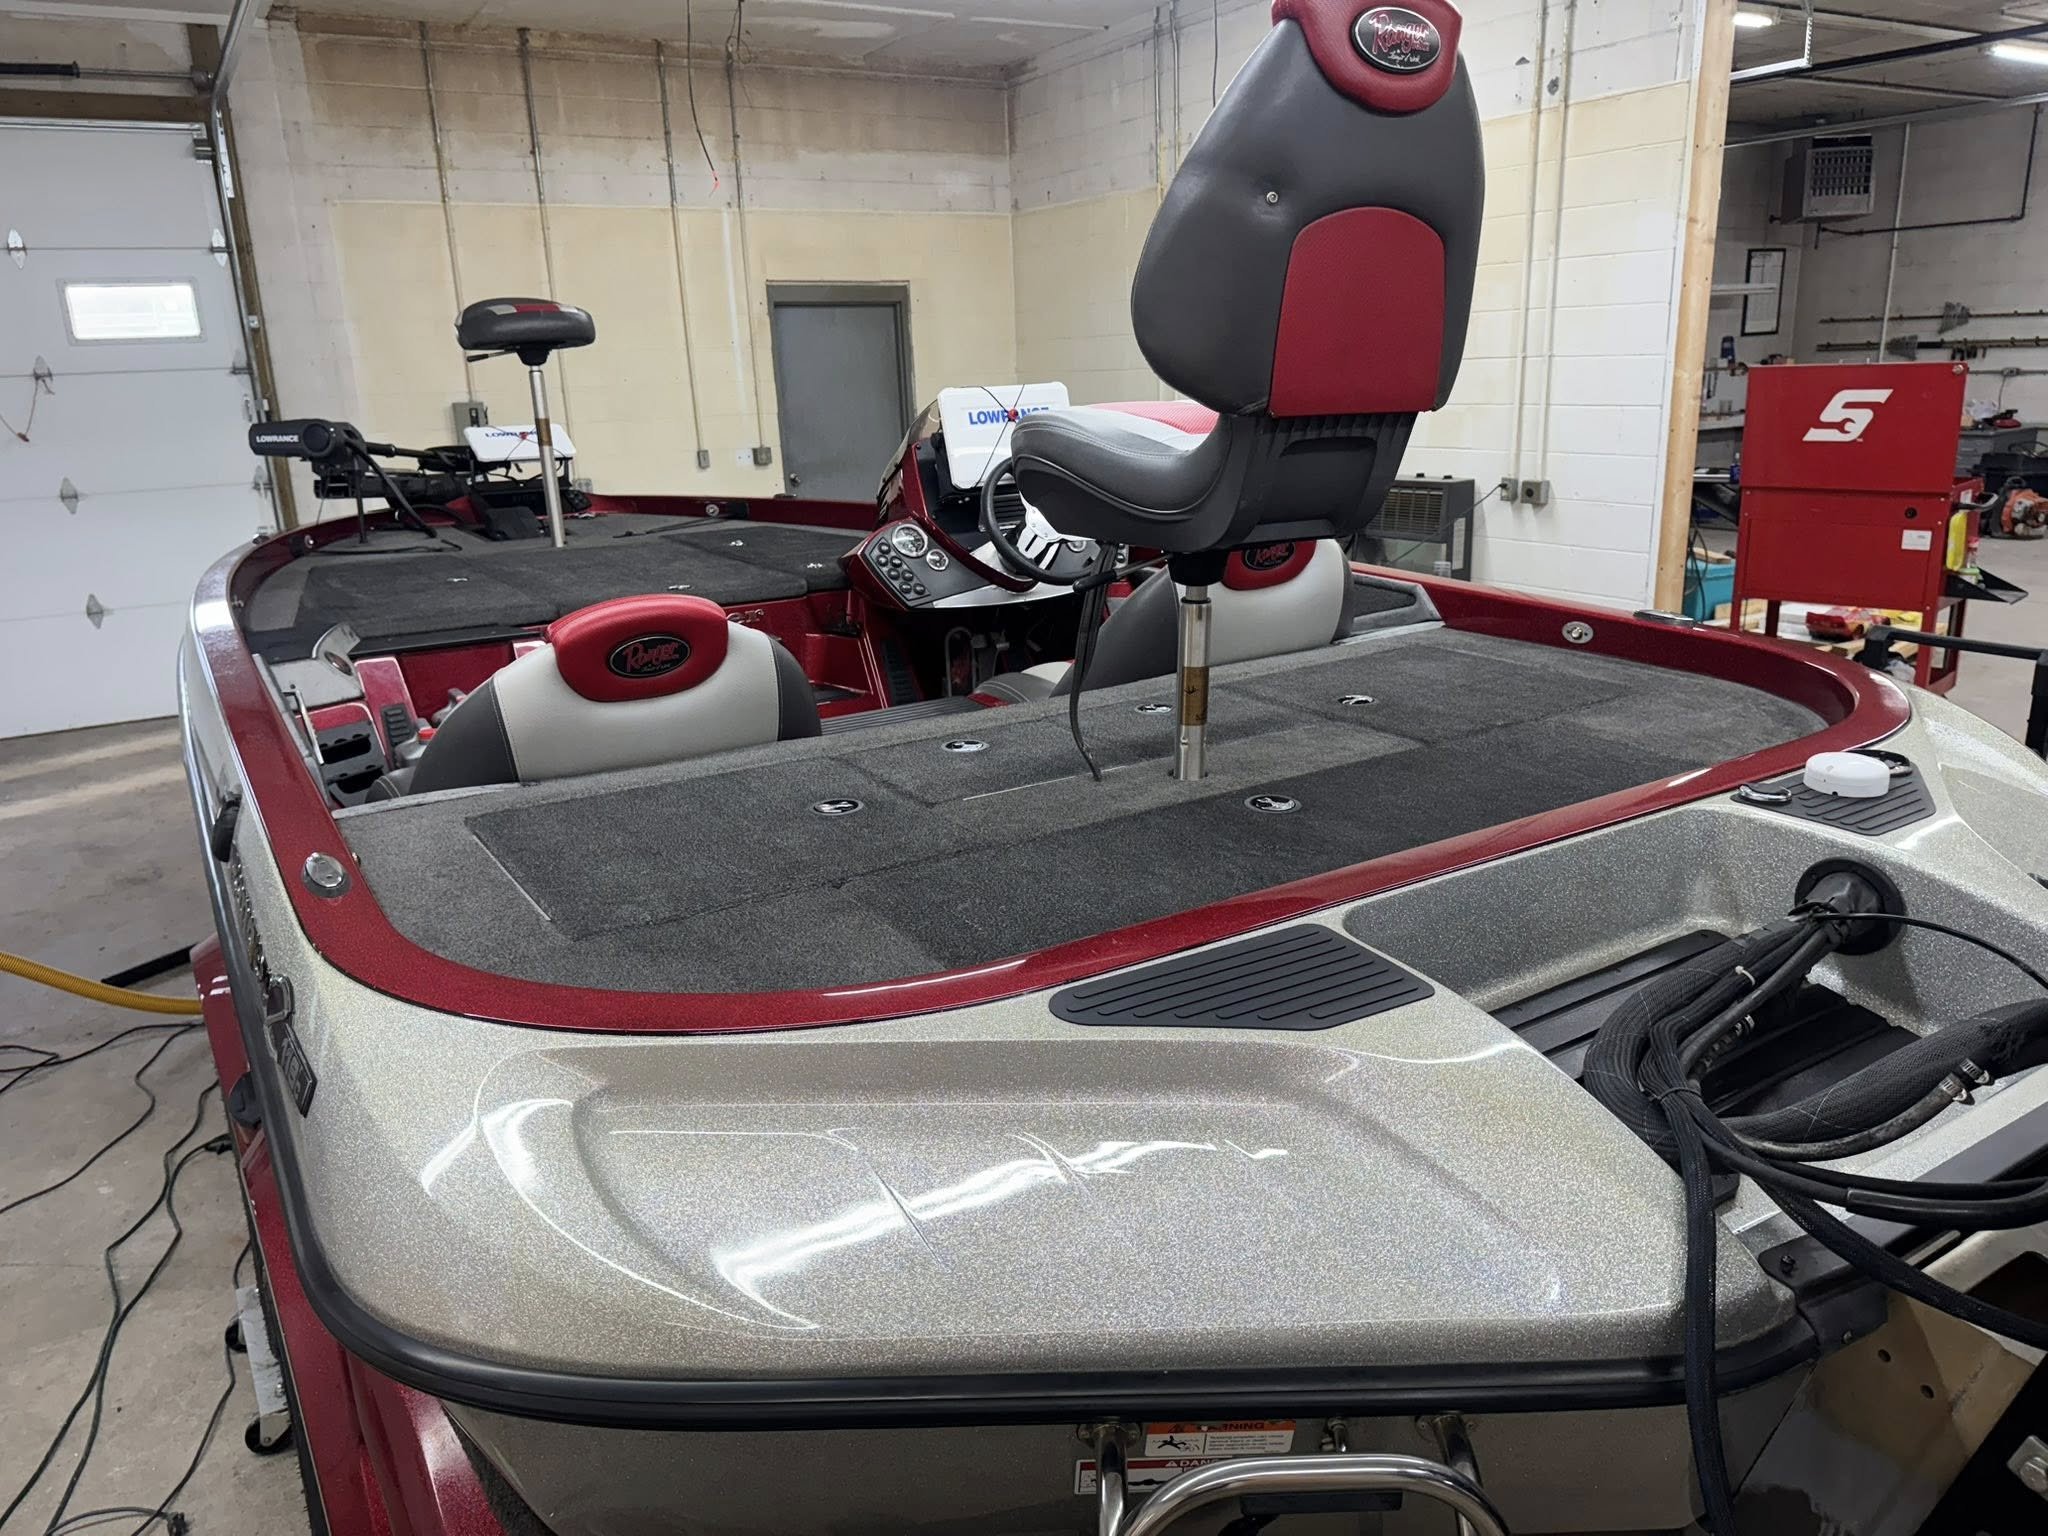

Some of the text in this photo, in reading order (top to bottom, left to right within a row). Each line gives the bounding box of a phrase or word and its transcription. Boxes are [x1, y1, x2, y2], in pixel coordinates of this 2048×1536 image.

[1368, 10, 1430, 55] Ranger
[256, 434, 300, 443] LOWRANCE
[622, 642, 680, 672] Ranger
